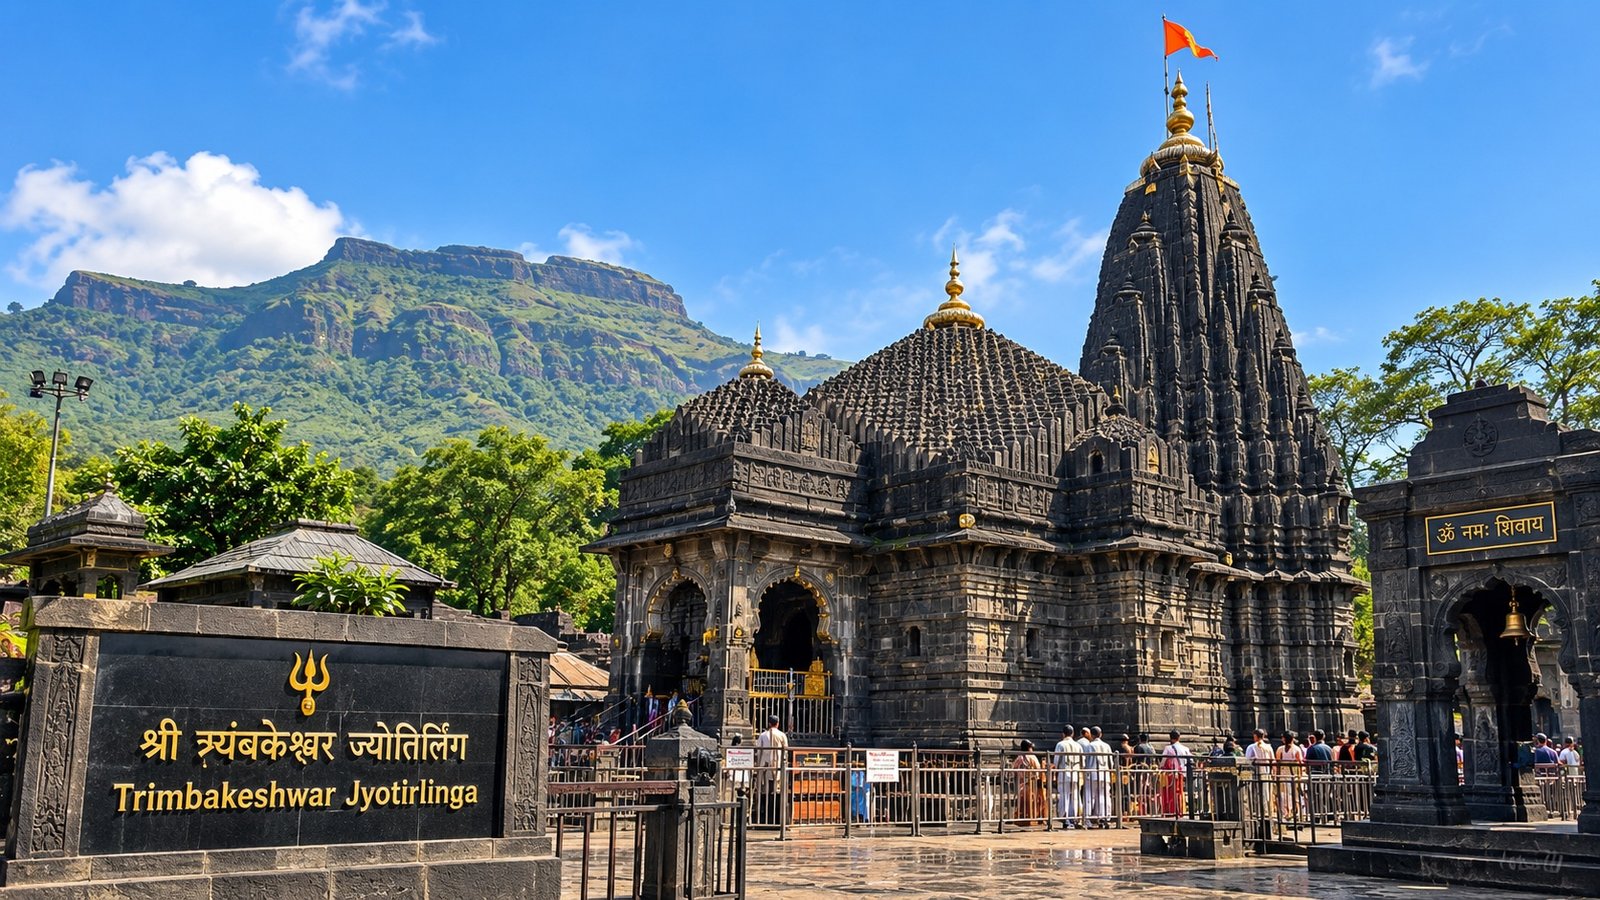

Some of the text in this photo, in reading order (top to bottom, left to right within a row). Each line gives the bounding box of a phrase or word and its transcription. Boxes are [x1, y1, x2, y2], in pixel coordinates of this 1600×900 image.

[1437, 514, 1544, 543] ॐ नमः शिवाय
[139, 718, 182, 761] श्री
[348, 721, 469, 761] ज्योतिर्लिंग
[114, 779, 478, 812] Trimbakeshwar Jyotirlinga
